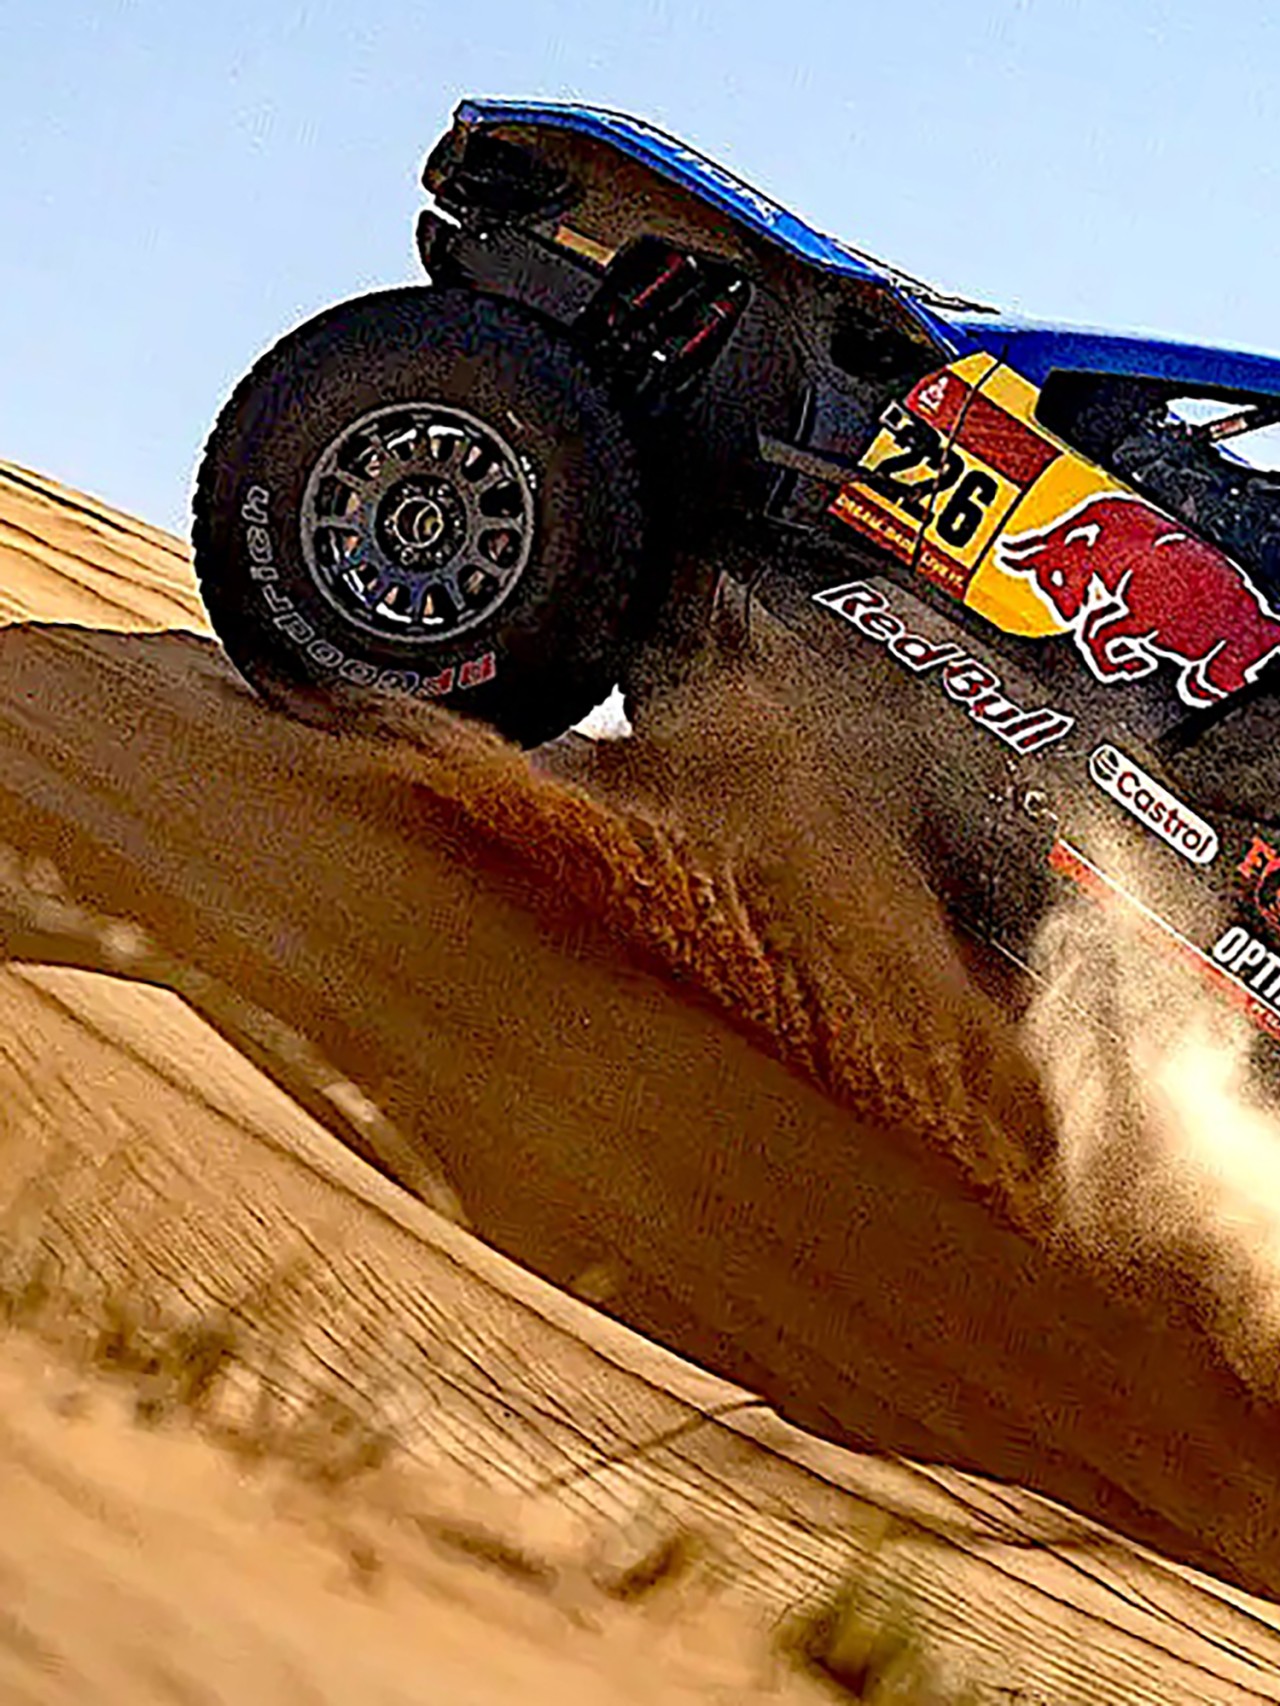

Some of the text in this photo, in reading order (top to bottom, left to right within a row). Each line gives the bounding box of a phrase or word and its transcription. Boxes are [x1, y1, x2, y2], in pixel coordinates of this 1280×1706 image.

[858, 412, 999, 548] 226
[812, 580, 1075, 754] Red Bull
[1116, 771, 1214, 857] Castrol
